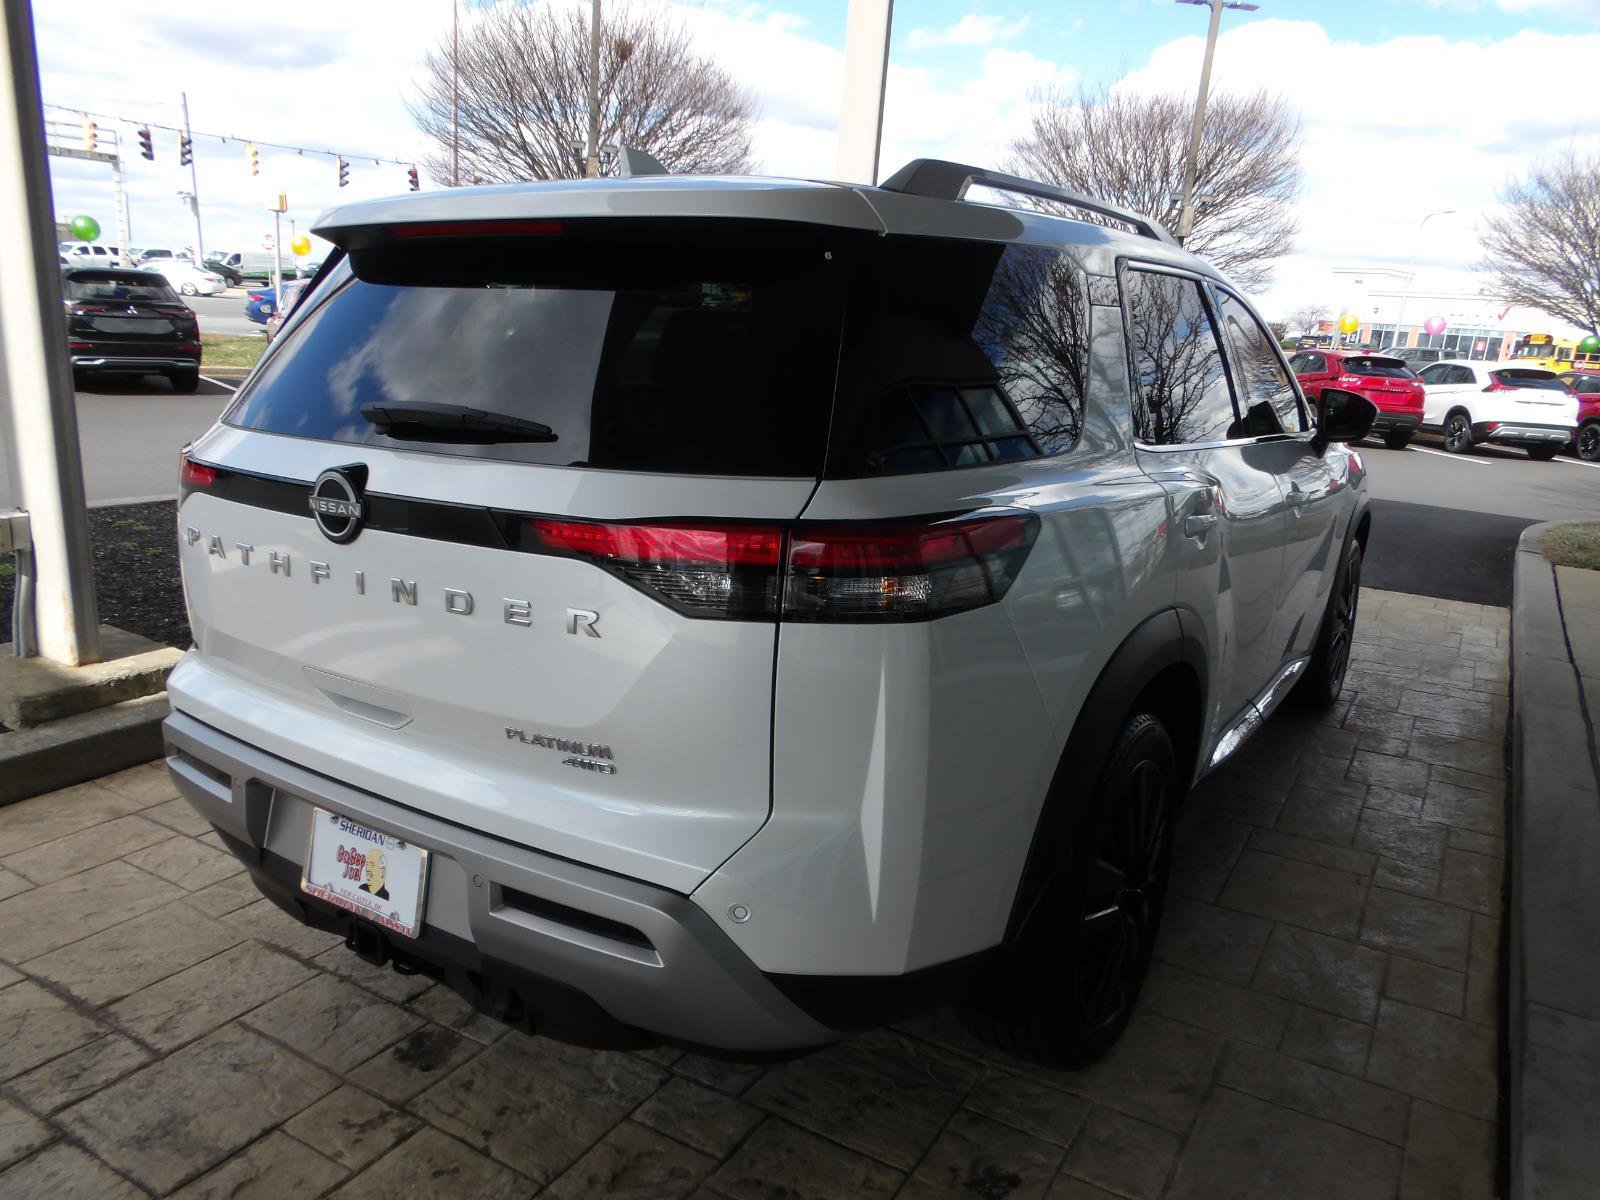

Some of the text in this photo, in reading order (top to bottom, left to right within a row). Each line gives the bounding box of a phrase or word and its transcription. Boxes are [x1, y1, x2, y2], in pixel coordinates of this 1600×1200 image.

[309, 497, 360, 516] NISSAN
[186, 525, 602, 639] PATHFINDER
[504, 725, 614, 760] PLATINUM
[561, 757, 617, 775] 4WD
[339, 820, 385, 846] SHERIDAN
